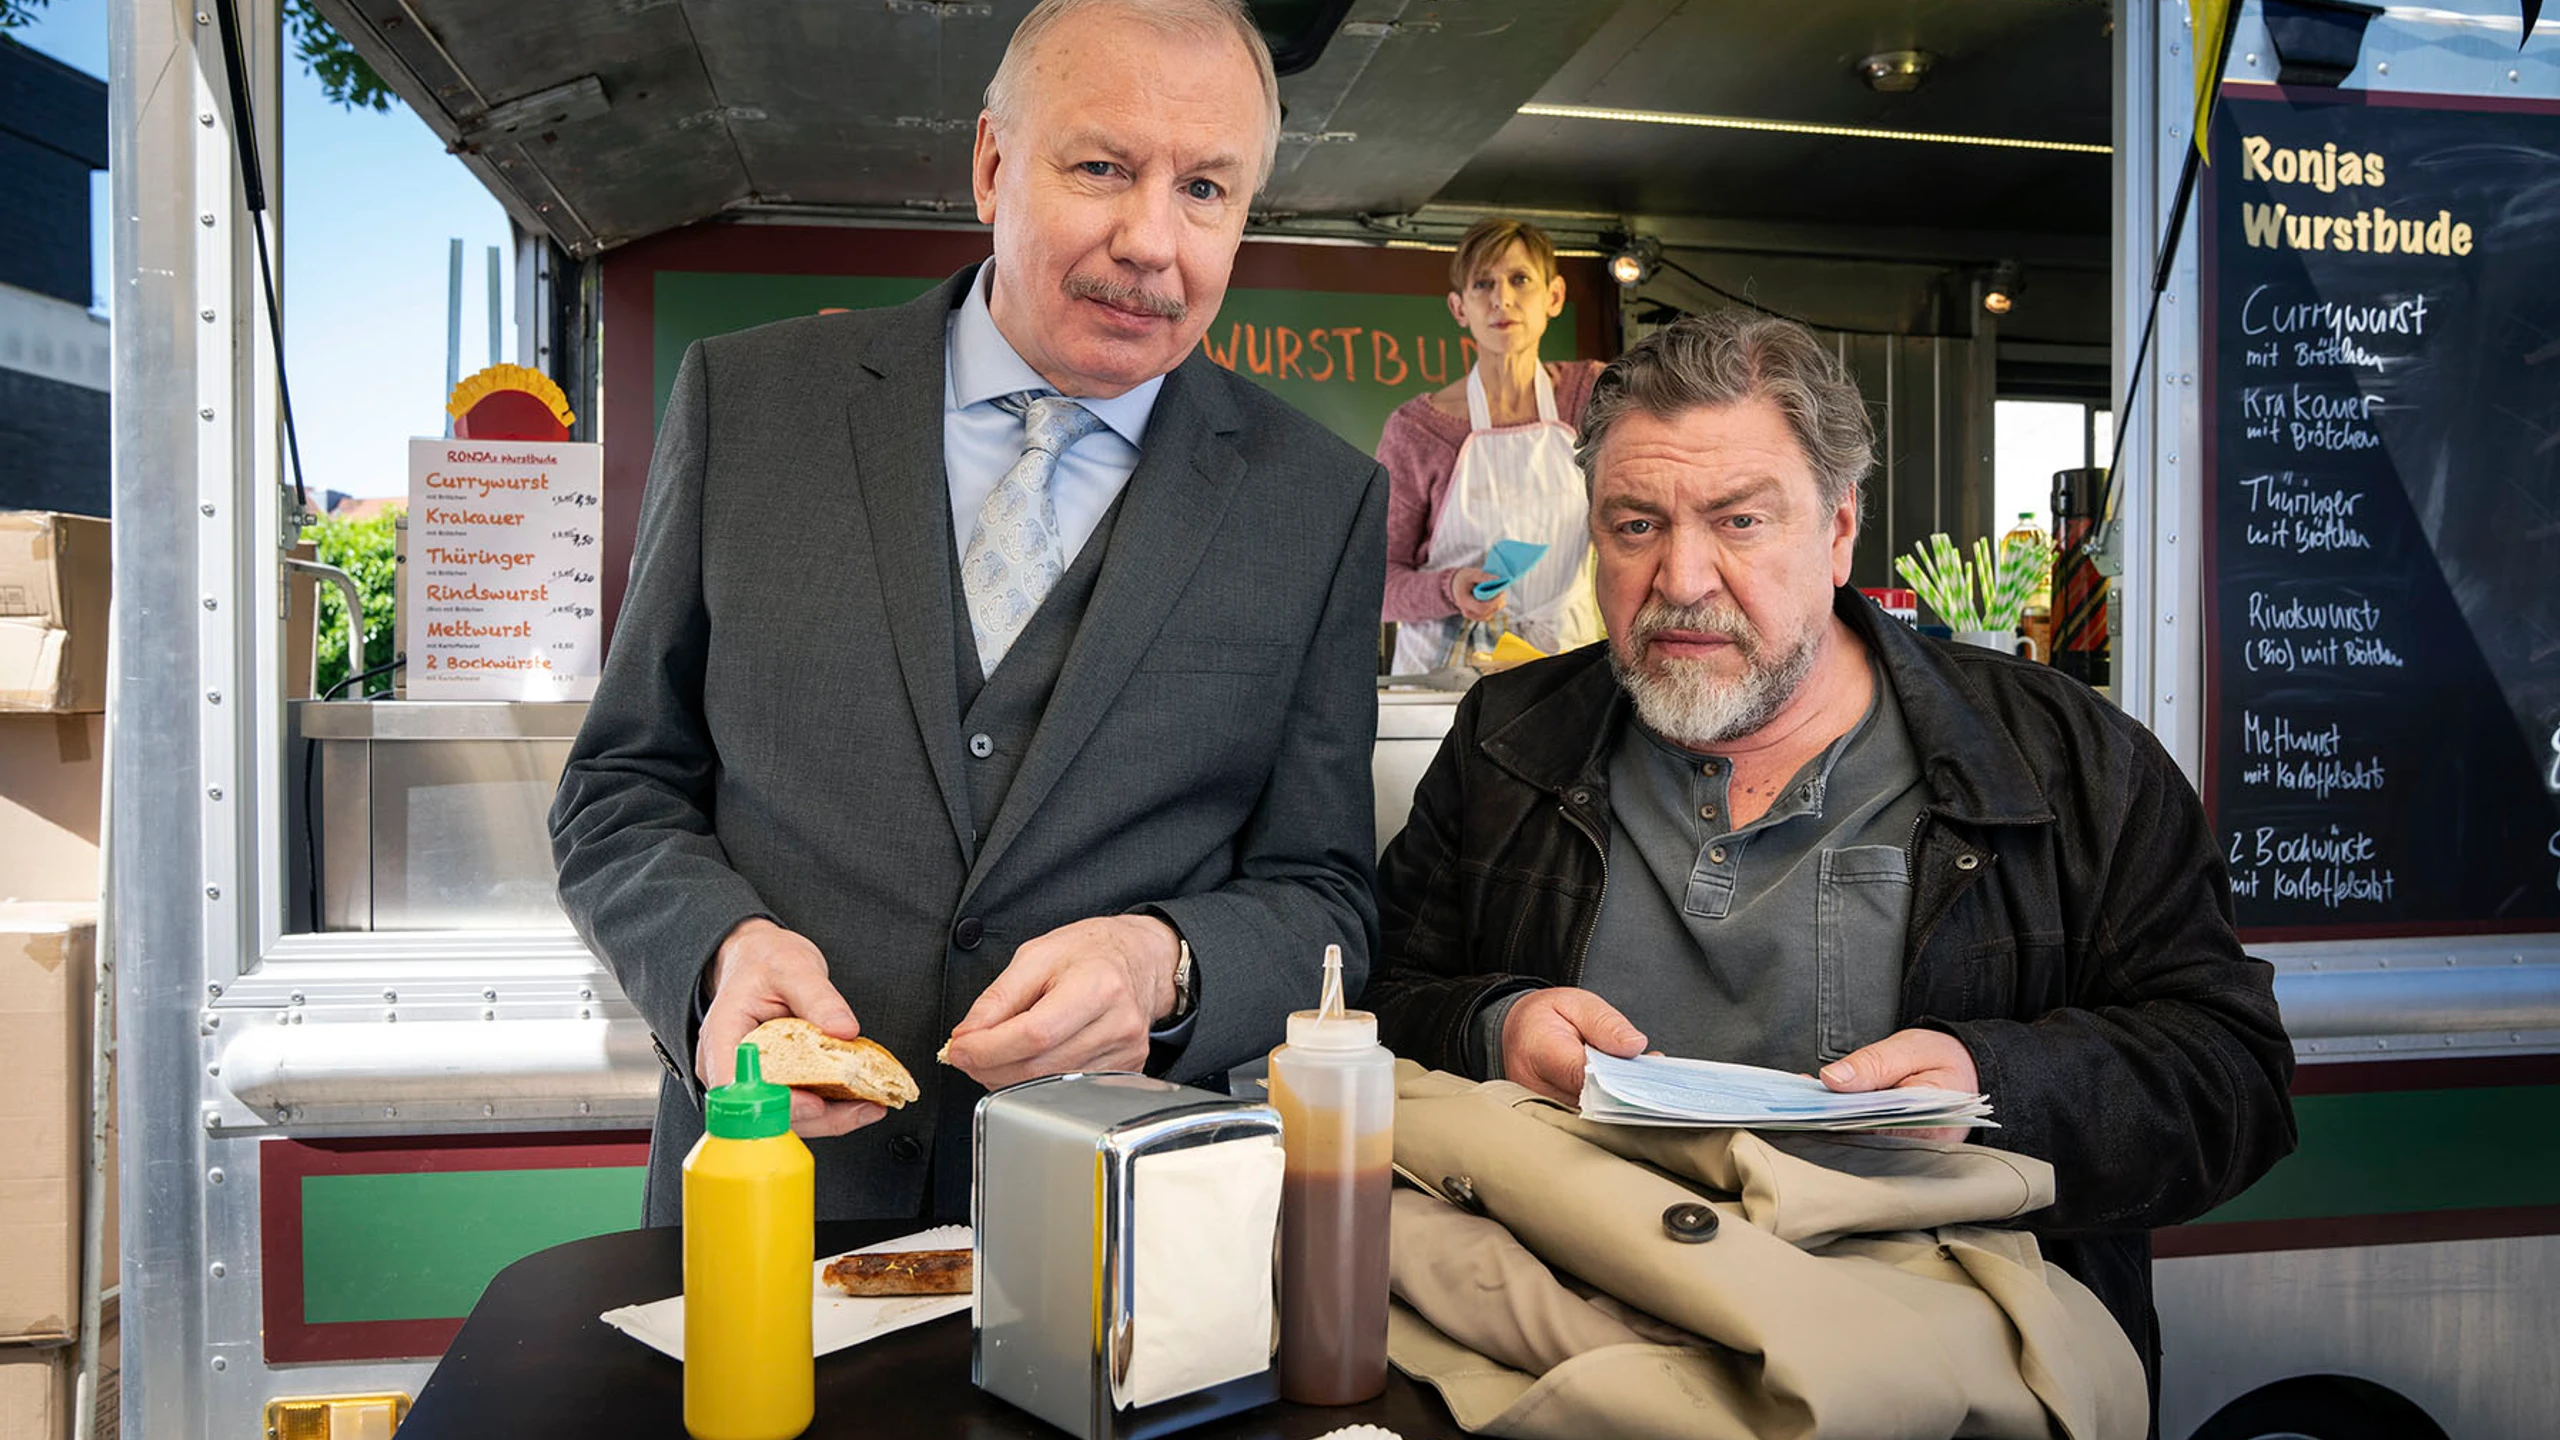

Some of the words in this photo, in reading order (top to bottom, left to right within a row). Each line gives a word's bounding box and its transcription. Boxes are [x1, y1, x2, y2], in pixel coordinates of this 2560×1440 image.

[2242, 135, 2386, 193] Ronjas
[2242, 201, 2474, 257] Wurstbude
[2241, 284, 2428, 341] Currywurst
[2246, 342, 2279, 367] mit
[2294, 336, 2384, 373] Brötchen
[2247, 418, 2280, 443] mit
[426, 472, 549, 498] Currywurst
[2239, 471, 2364, 519] Thüringer
[426, 505, 526, 526] Krakauer
[2247, 518, 2290, 548] mit
[426, 547, 536, 571] Thüringer
[426, 581, 549, 602] Rindswurst
[2249, 591, 2381, 632] Rindswurst
[426, 619, 532, 638] Mettwurst
[426, 653, 438, 670] 2
[446, 655, 553, 670] Bockwürste
[2245, 637, 2295, 672] (Bio)
[2301, 637, 2338, 666] mit
[2244, 710, 2341, 759] Mettwurst
[2244, 763, 2270, 784] mit
[2229, 831, 2244, 864] 2
[2229, 869, 2259, 898] mit
